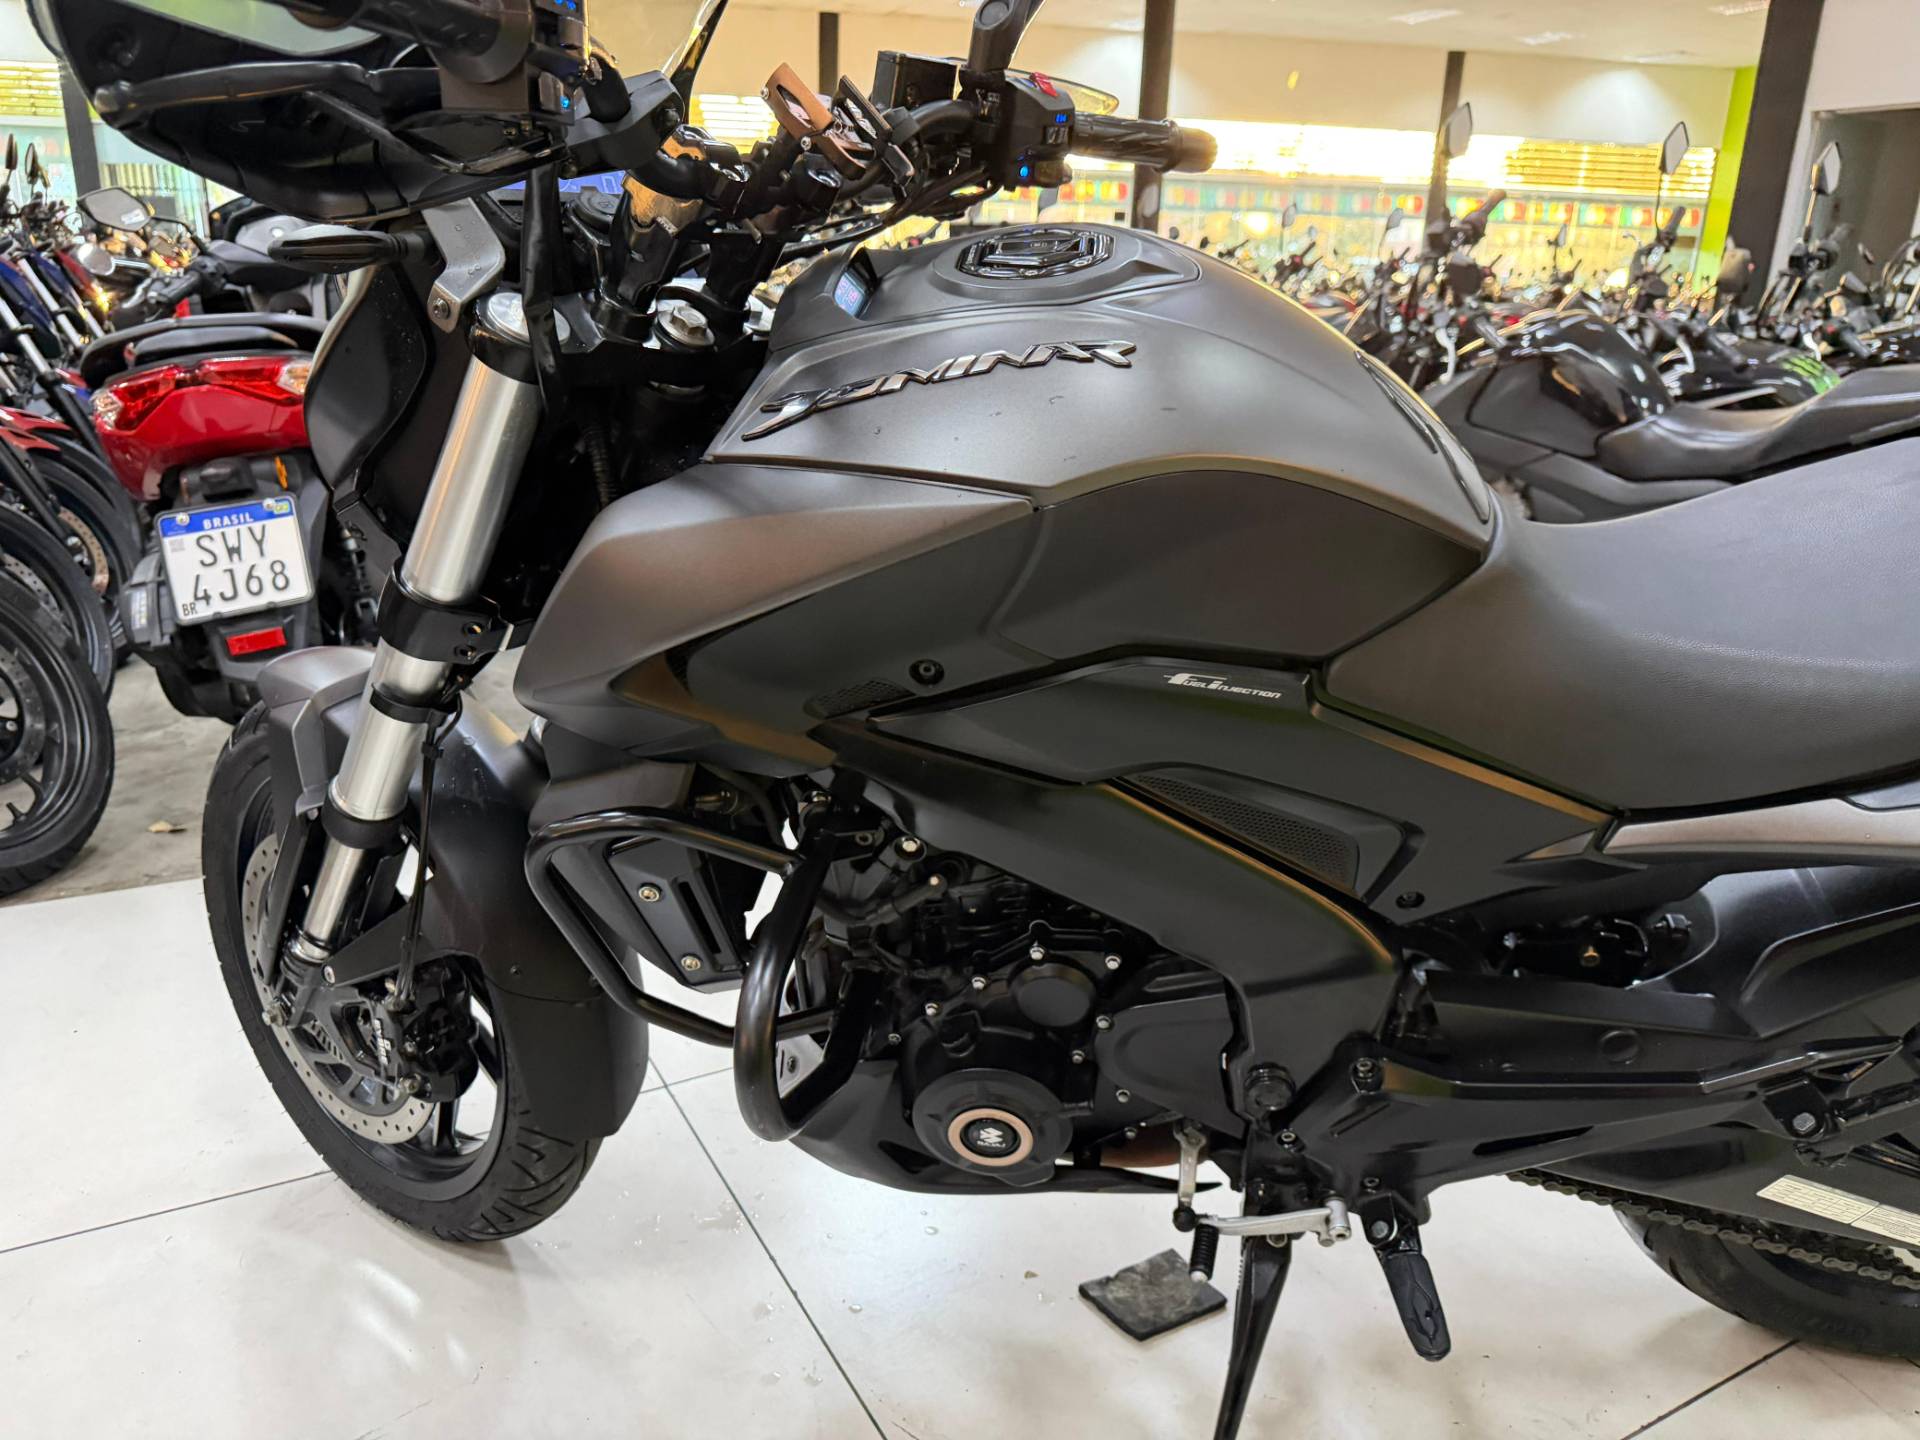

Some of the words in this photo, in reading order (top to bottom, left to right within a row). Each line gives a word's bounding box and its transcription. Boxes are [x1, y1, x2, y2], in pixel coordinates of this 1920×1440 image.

[741, 340, 1137, 441] DOMINAR
[202, 512, 254, 530] BRASIL
[195, 524, 267, 567] SWY
[193, 559, 290, 607] 4J68
[182, 602, 198, 617] BR
